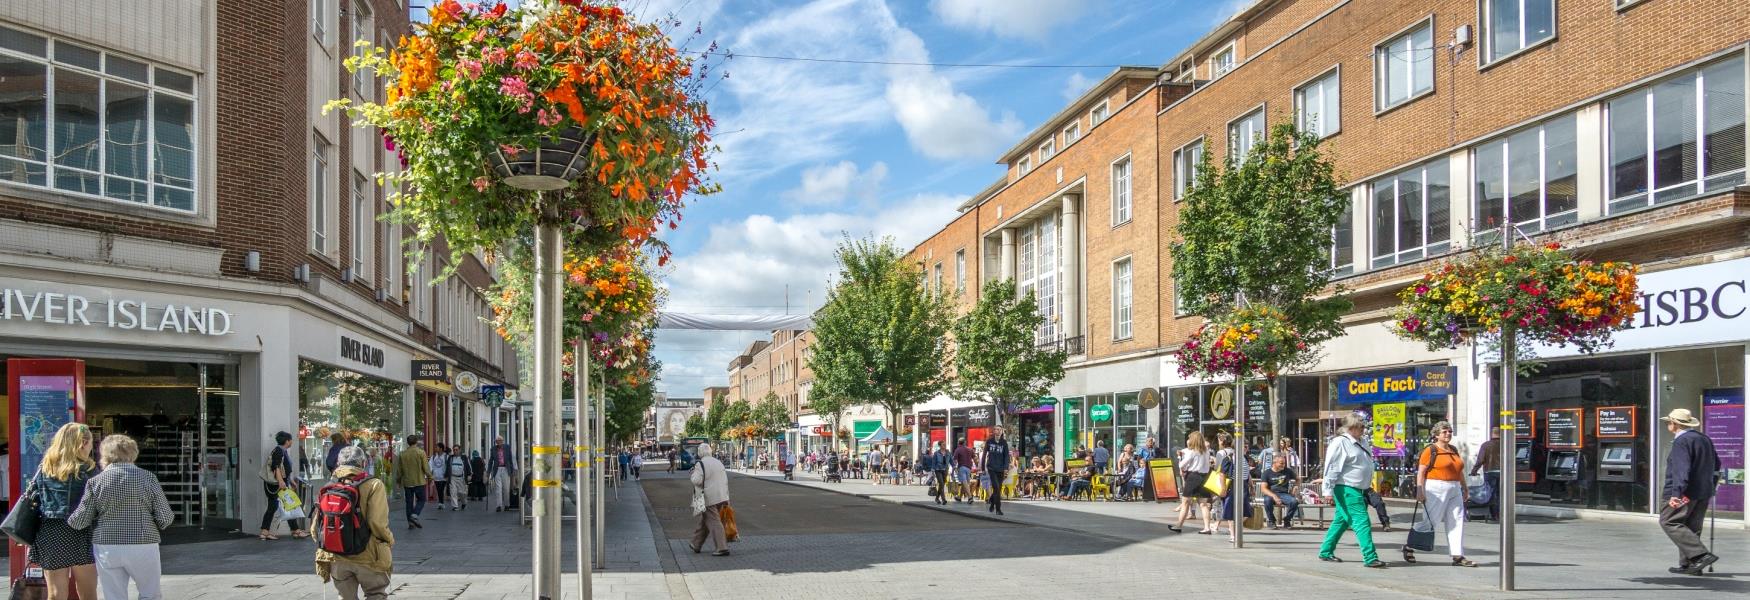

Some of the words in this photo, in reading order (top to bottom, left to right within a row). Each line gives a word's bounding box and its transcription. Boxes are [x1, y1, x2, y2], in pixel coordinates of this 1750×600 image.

[0, 288, 91, 326] IVER
[107, 297, 231, 336] ISLAND
[341, 336, 362, 362] RIVER
[362, 344, 384, 369] ISLAND
[1426, 371, 1446, 380] Card
[1348, 379, 1378, 394] Card
[1384, 375, 1416, 392] Fact
[1420, 380, 1450, 389] Factory
[1146, 393, 1154, 402] A
